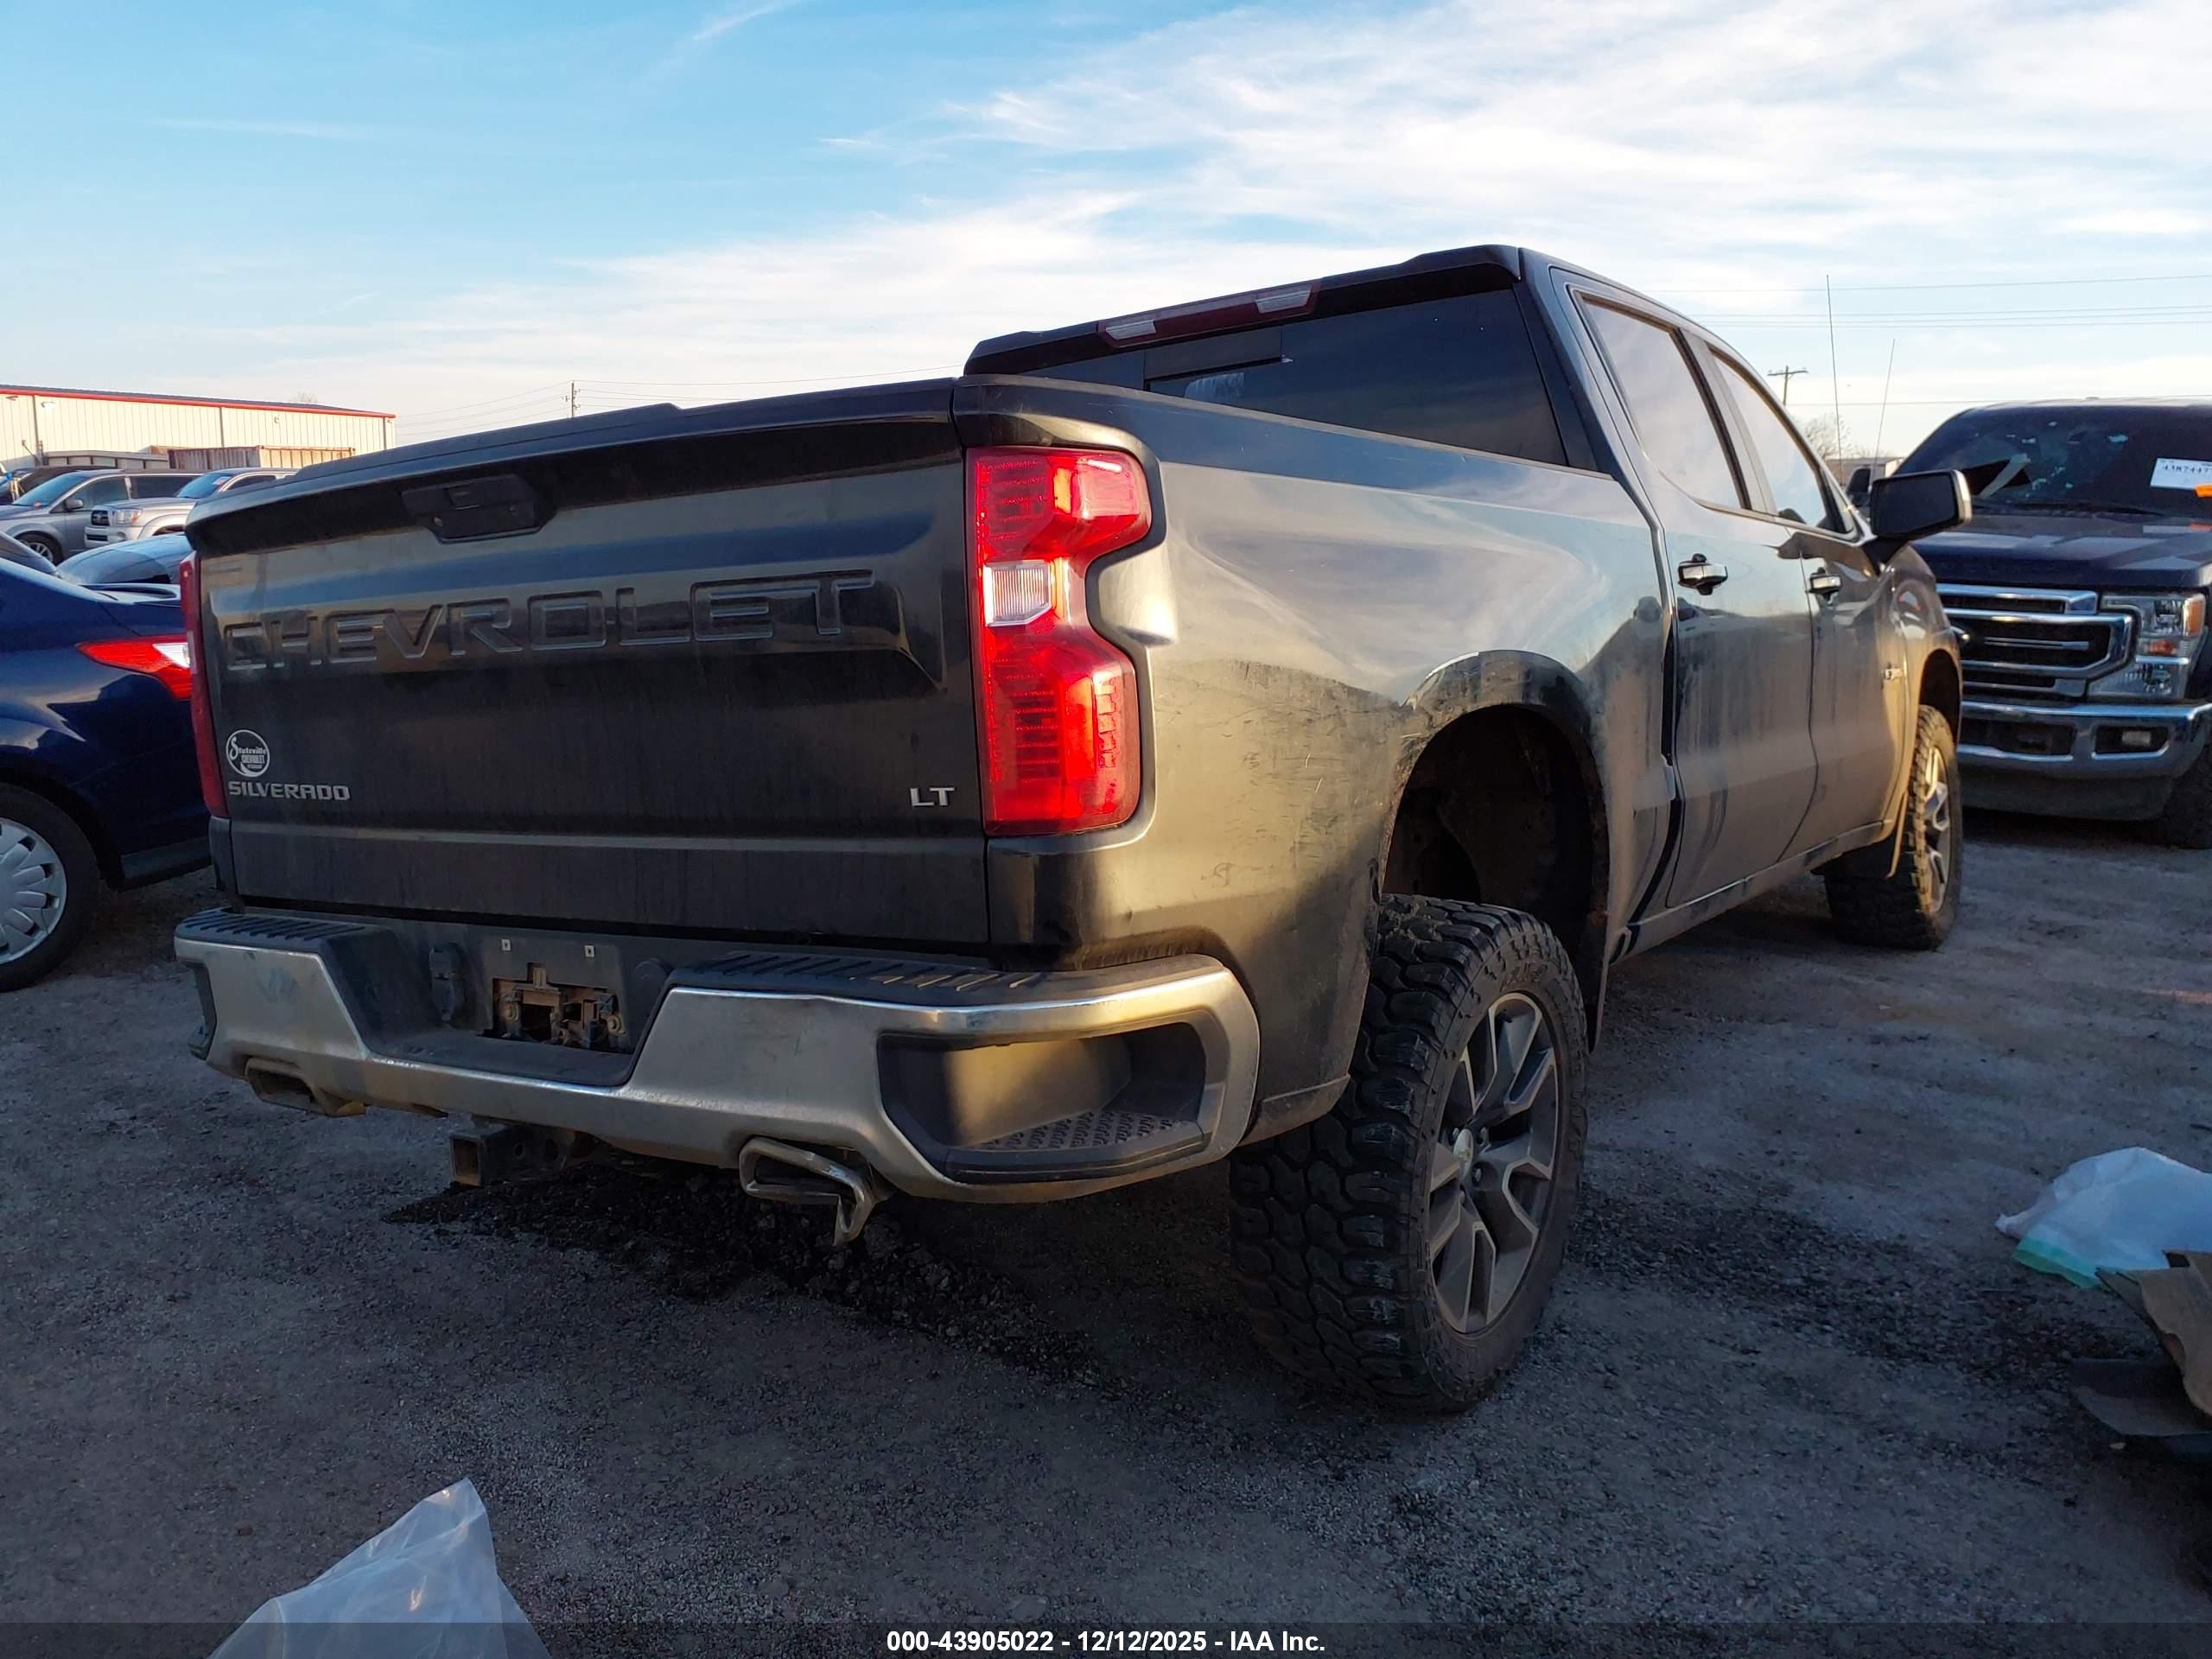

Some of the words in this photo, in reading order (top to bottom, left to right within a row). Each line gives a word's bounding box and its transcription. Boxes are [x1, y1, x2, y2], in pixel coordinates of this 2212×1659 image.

[225, 569, 874, 671] CHEVROLET
[228, 781, 351, 800] SILVERADO
[910, 787, 955, 806] LT
